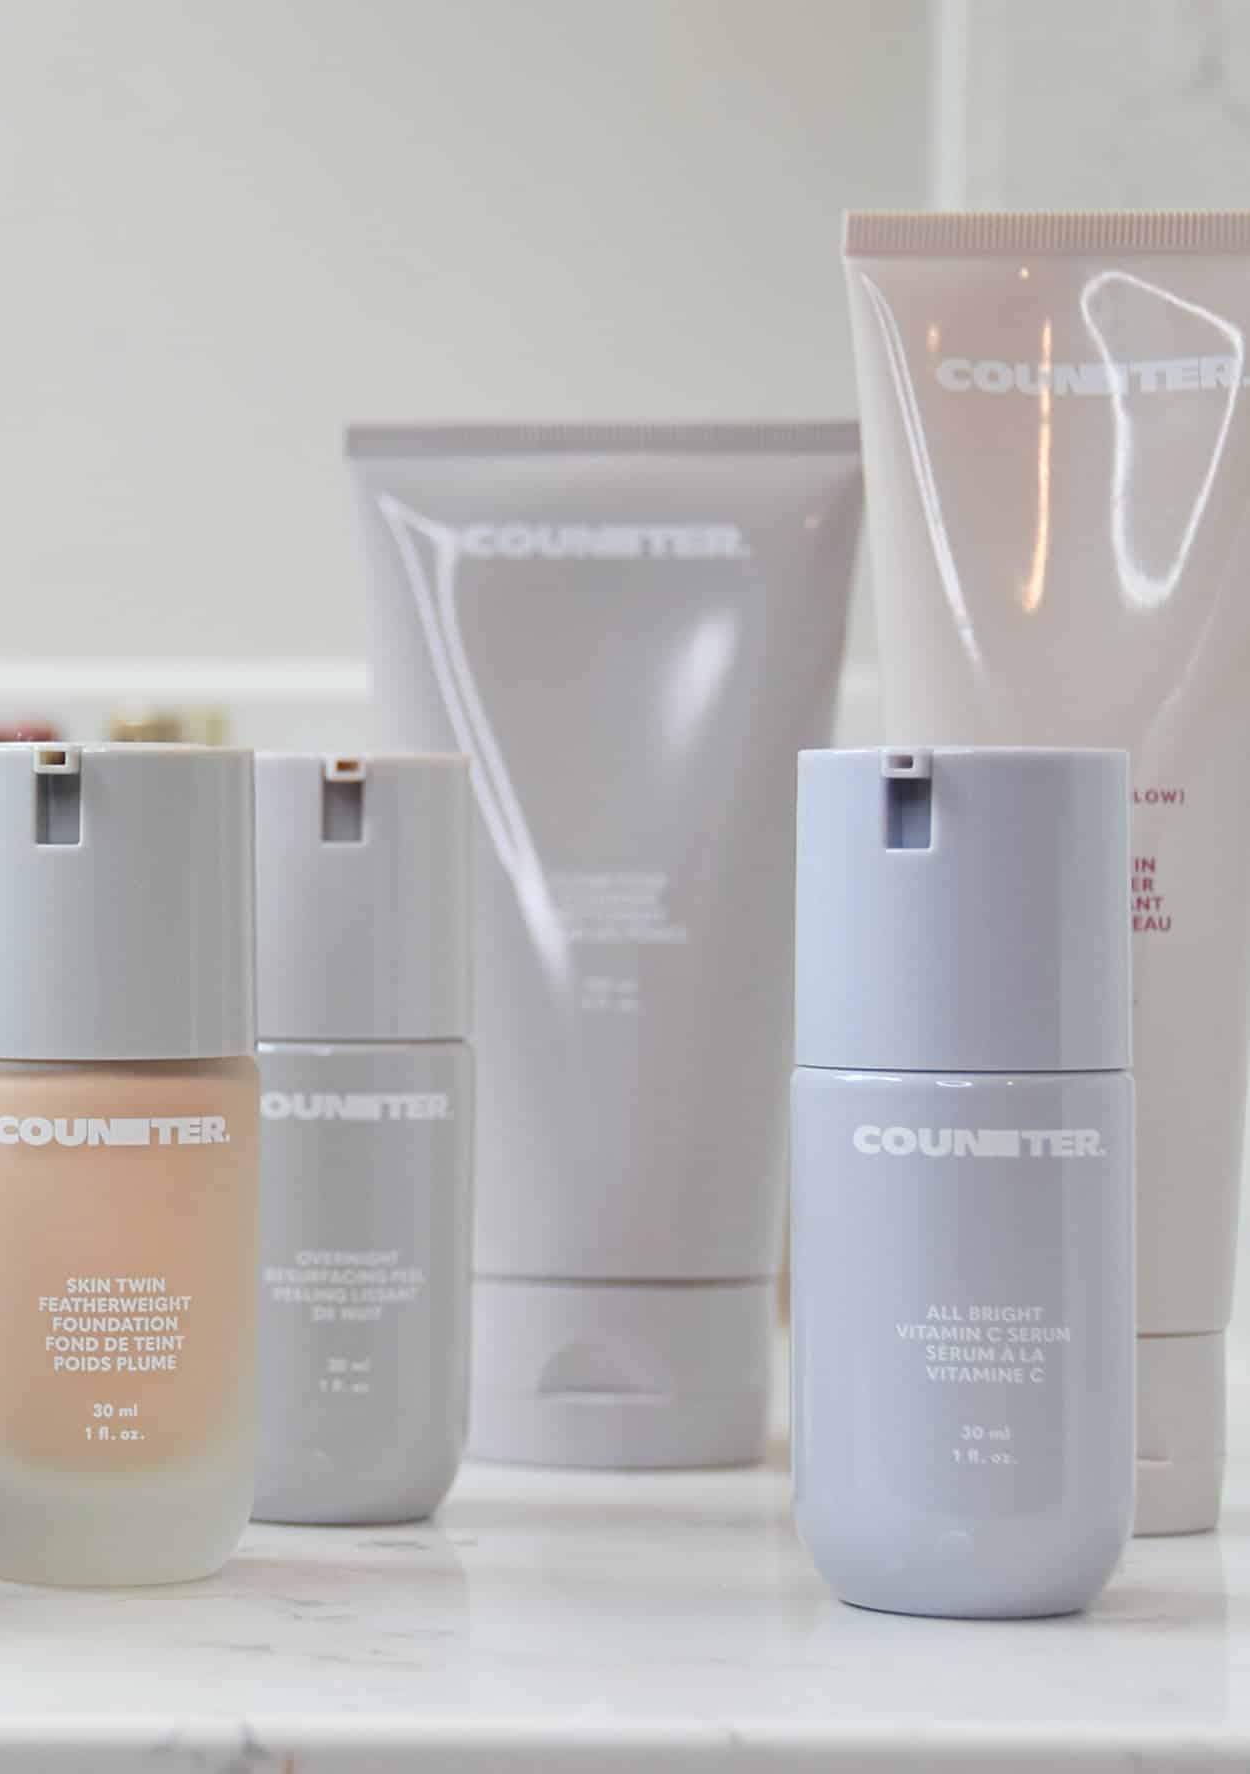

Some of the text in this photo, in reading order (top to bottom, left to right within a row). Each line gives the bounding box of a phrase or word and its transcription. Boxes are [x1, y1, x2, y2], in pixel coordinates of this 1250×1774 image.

[1134, 787, 1185, 806] LOW)
[1132, 896, 1163, 912] NT
[260, 1093, 453, 1121] OUNTER.
[853, 1125, 1106, 1156] COUNTER.
[66, 1278, 166, 1293] SKIN TWIN
[38, 1296, 192, 1313] FEATHERWEIGHT
[926, 1305, 1044, 1322] ALL BRIGHT
[52, 1316, 179, 1332] FOUNDATION
[896, 1324, 981, 1341] VITAMIN
[987, 1326, 1001, 1341] C
[45, 1336, 185, 1352] FOND DE TEINT
[926, 1343, 994, 1362] SÉRUM
[1019, 1347, 1045, 1362] LA
[54, 1356, 177, 1372] POIDS PLUME
[926, 1366, 1045, 1384] VITAMINE C
[93, 1404, 138, 1418] 30 ml
[85, 1427, 145, 1440] 1 fl. oz.
[960, 1425, 1011, 1440] 30 ml
[952, 1448, 960, 1464] 1
[968, 1448, 987, 1464] fl.
